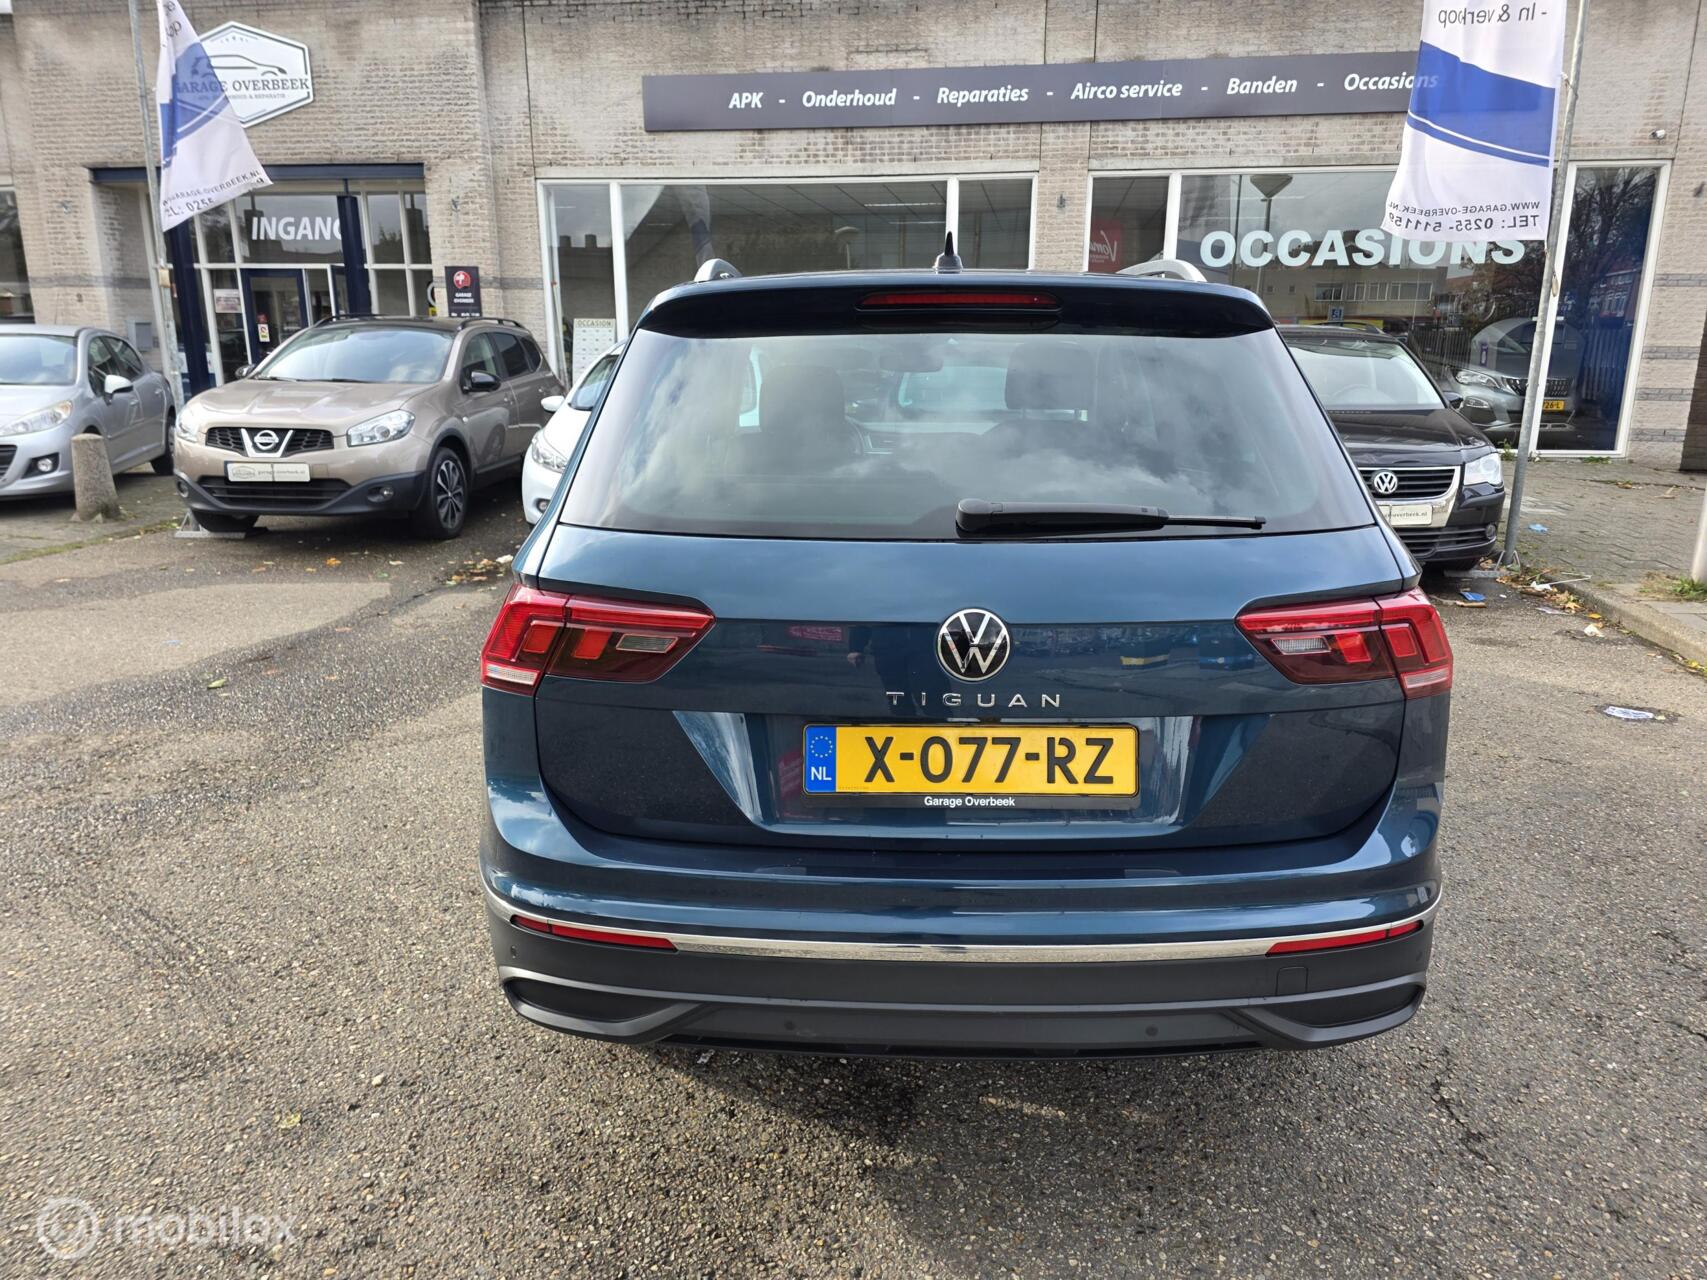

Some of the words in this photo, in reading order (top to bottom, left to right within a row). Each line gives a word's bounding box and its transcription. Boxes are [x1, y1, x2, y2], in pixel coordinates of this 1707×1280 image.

[232, 78, 310, 92] OVERBEEK
[728, 91, 764, 109] APK
[802, 88, 897, 107] Onderhoud
[936, 85, 1030, 107] Reparaties
[1070, 82, 1117, 100] Airco
[1119, 80, 1183, 98] service
[1226, 76, 1298, 96] Banden
[1343, 72, 1439, 91] Occasions
[1200, 229, 1526, 267] OCCASIONS
[885, 690, 1061, 708] TIGUAN
[864, 736, 1114, 784] X-077-RZ
[810, 766, 832, 781] NL
[924, 796, 963, 809] Garage
[965, 796, 1015, 807] Overbeek
